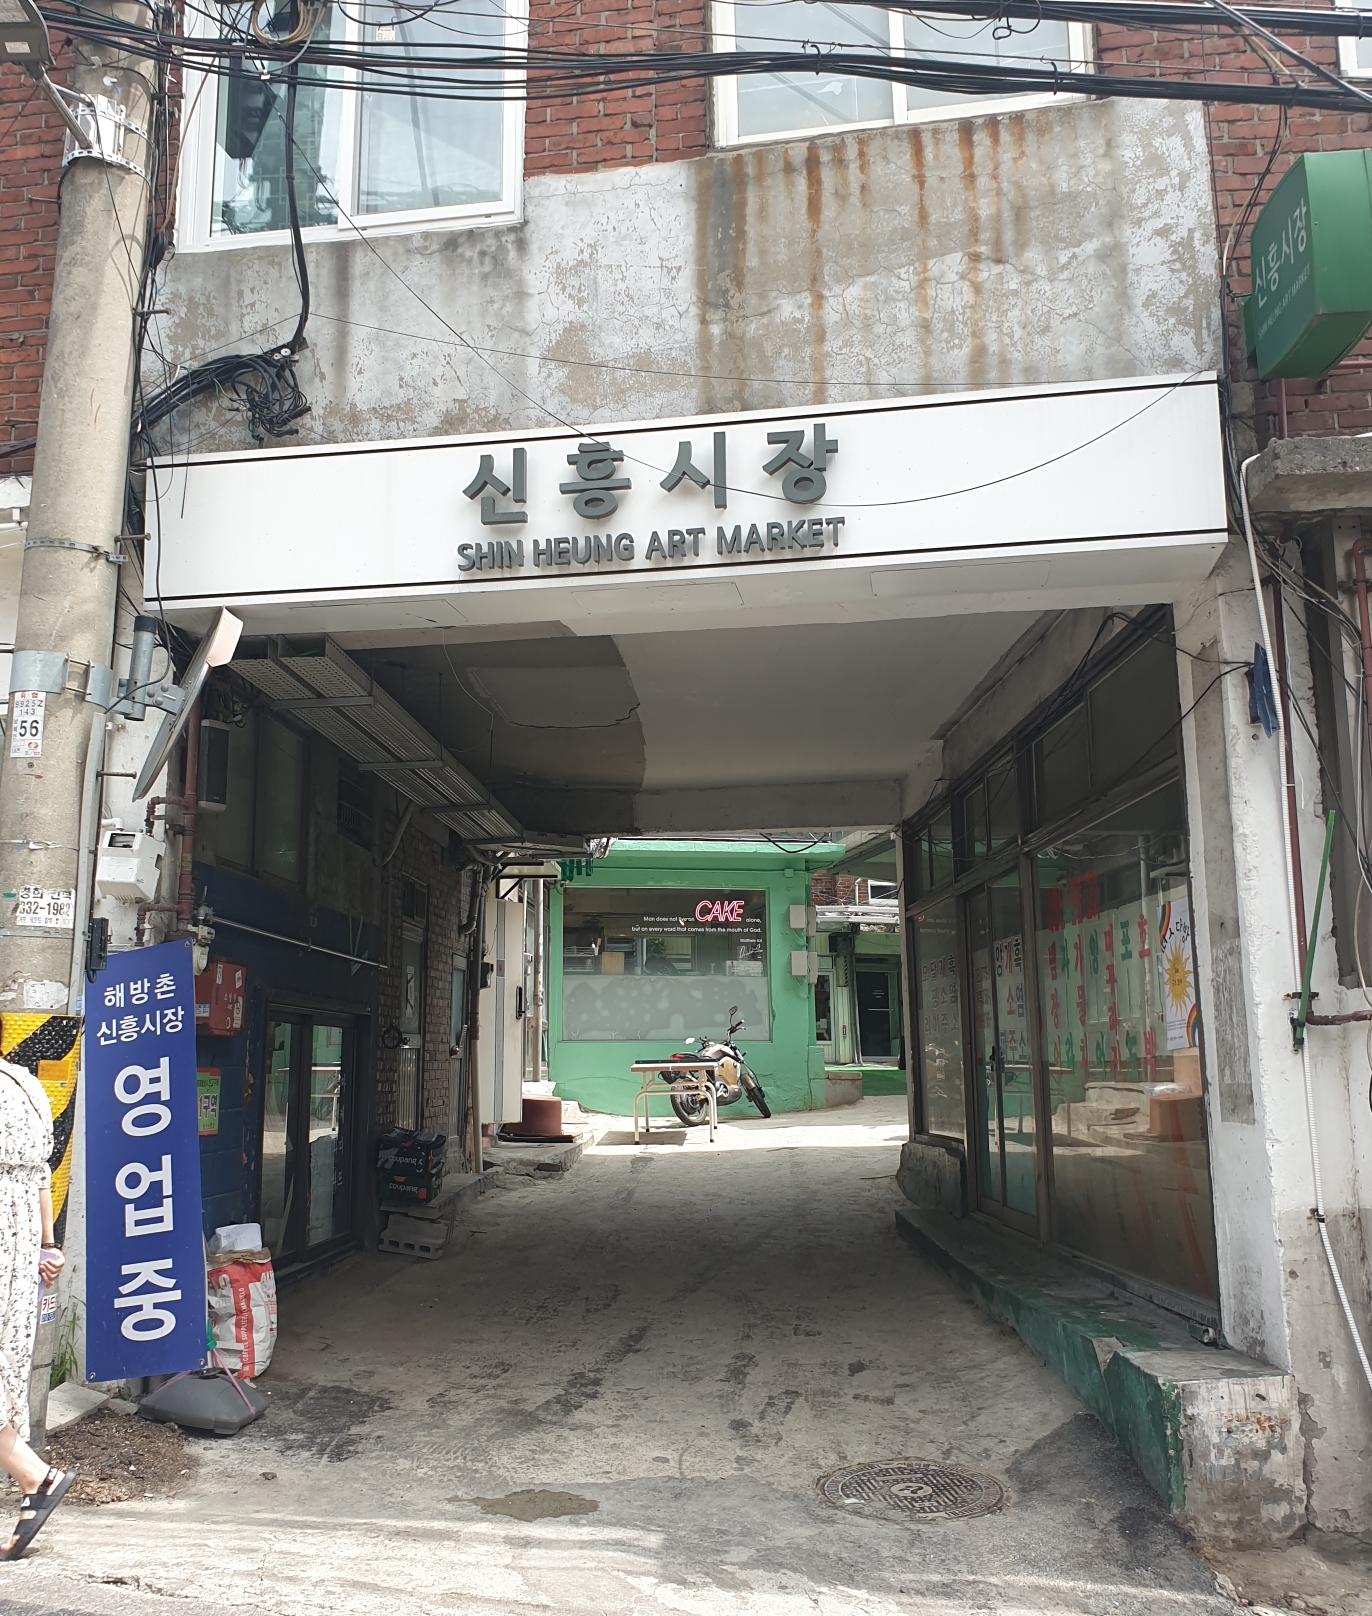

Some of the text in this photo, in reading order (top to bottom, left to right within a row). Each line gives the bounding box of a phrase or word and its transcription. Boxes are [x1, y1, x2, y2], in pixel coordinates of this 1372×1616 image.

[1254, 198, 1307, 309] 신흥시장
[1291, 262, 1311, 298] MARKET
[462, 423, 839, 526] 신흥시장
[457, 516, 846, 572] SHIN HEUNG ART MARKET
[19, 708, 36, 716] 143
[19, 719, 39, 737] 56
[695, 900, 745, 922] CAKE
[103, 972, 177, 1008] 해방촌
[1073, 933, 1090, 1079] 가물치
[1089, 929, 1107, 1077] 잉어
[96, 1005, 185, 1046] 신흥시장
[198, 1094, 218, 1119] 1구역
[388, 1155, 417, 1166] coupang
[113, 1056, 182, 1342] 영업중
[388, 1182, 419, 1195] coupang
[42, 1296, 56, 1312] 카드
